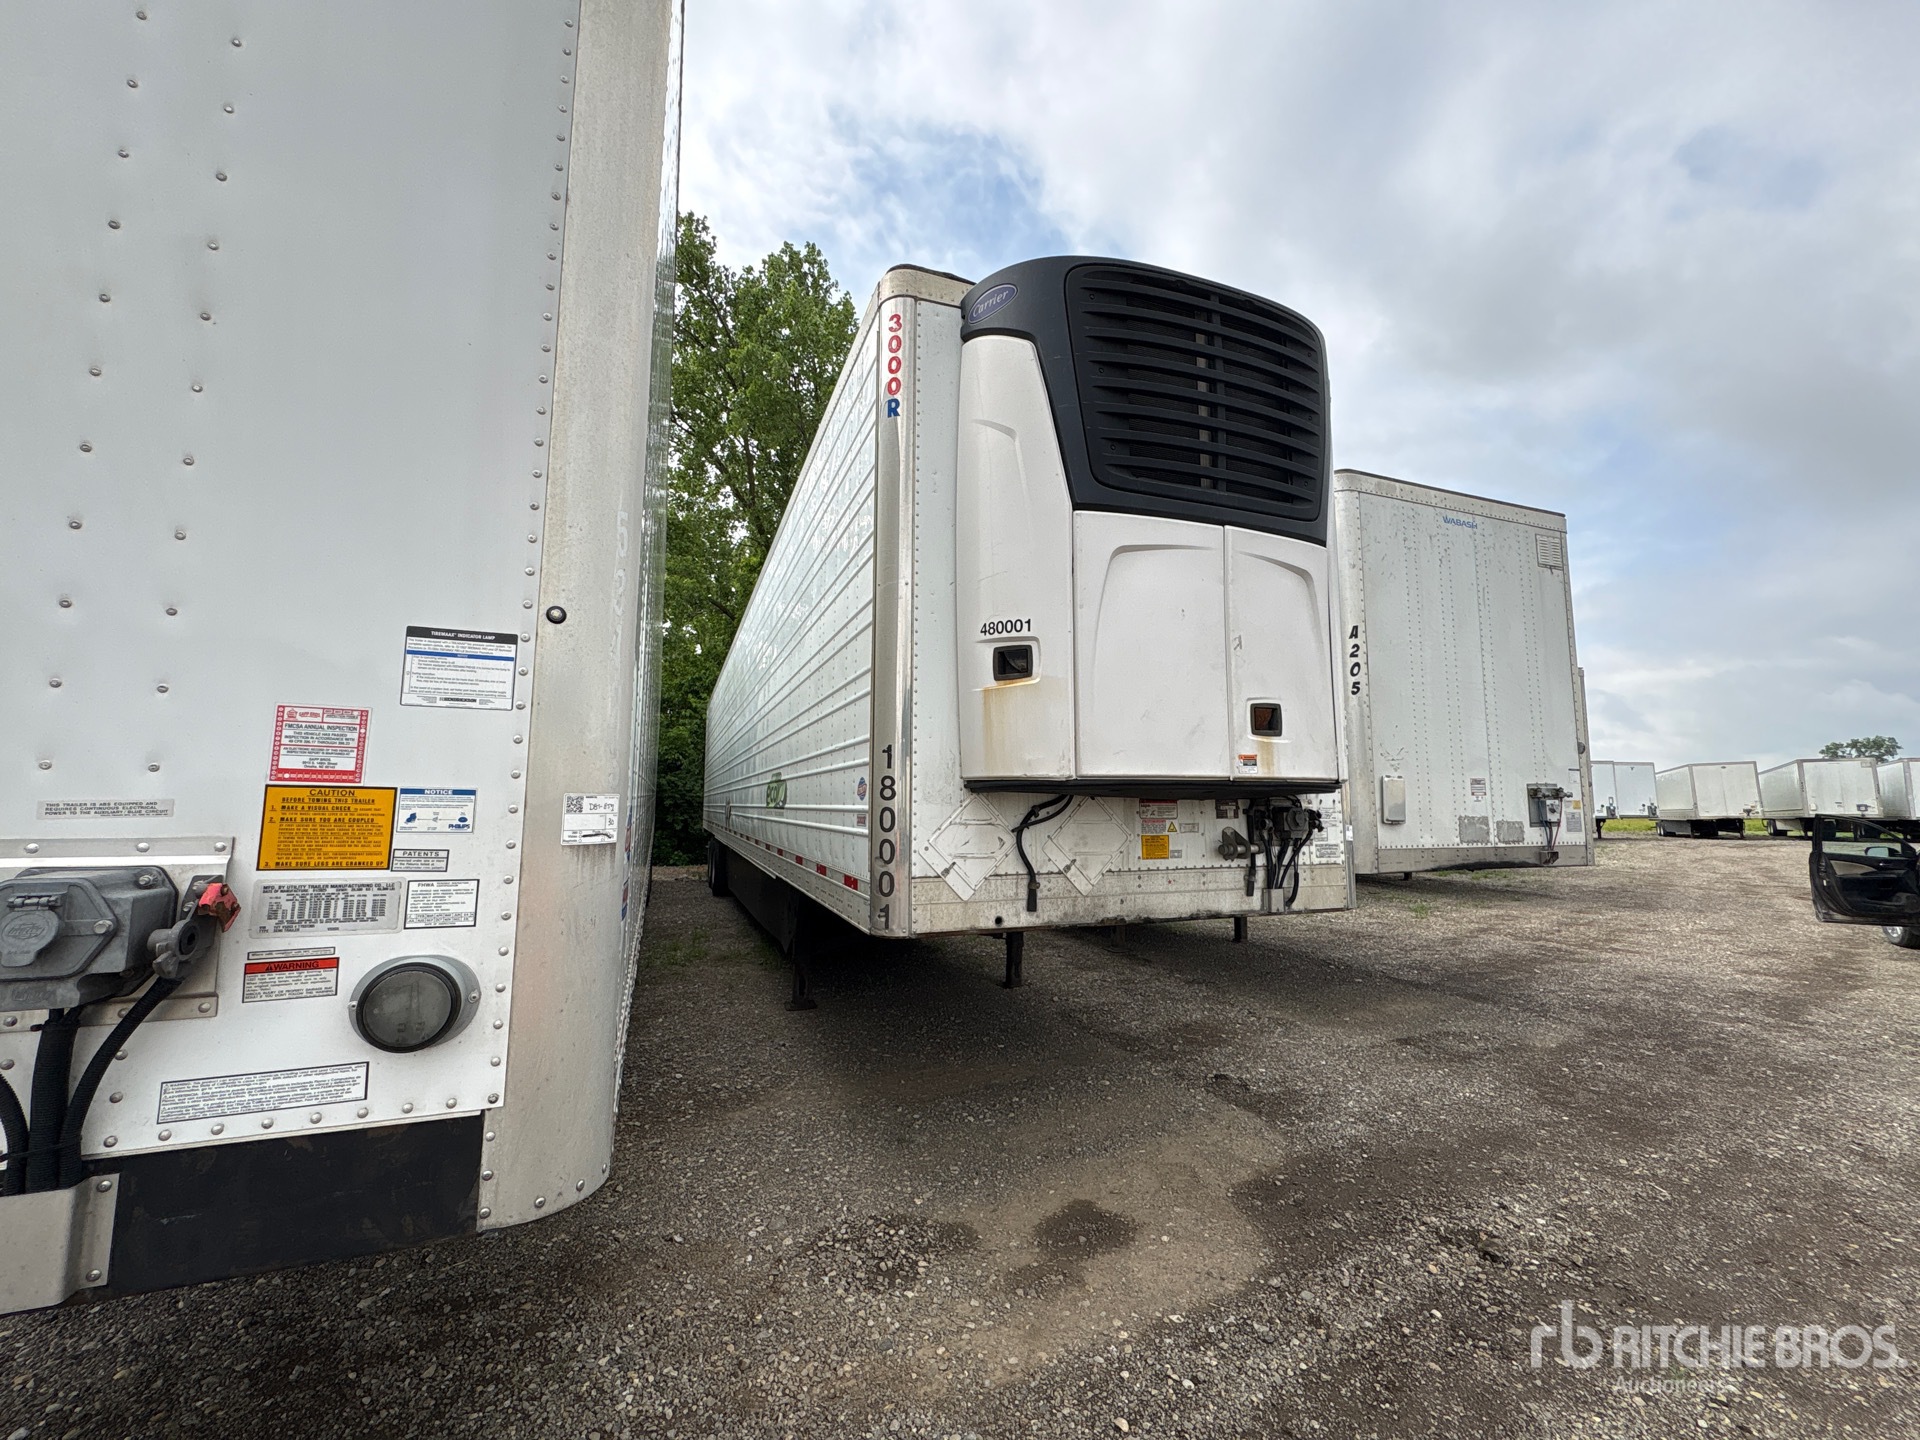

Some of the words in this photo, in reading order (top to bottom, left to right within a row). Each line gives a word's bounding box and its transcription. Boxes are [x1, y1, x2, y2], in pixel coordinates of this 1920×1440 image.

[973, 290, 1009, 317] Carrier
[1442, 514, 1478, 530] WABASH
[980, 618, 1031, 636] 480001
[1348, 625, 1361, 695] A205
[877, 744, 897, 930] 180001
[273, 961, 319, 970] WARNING
